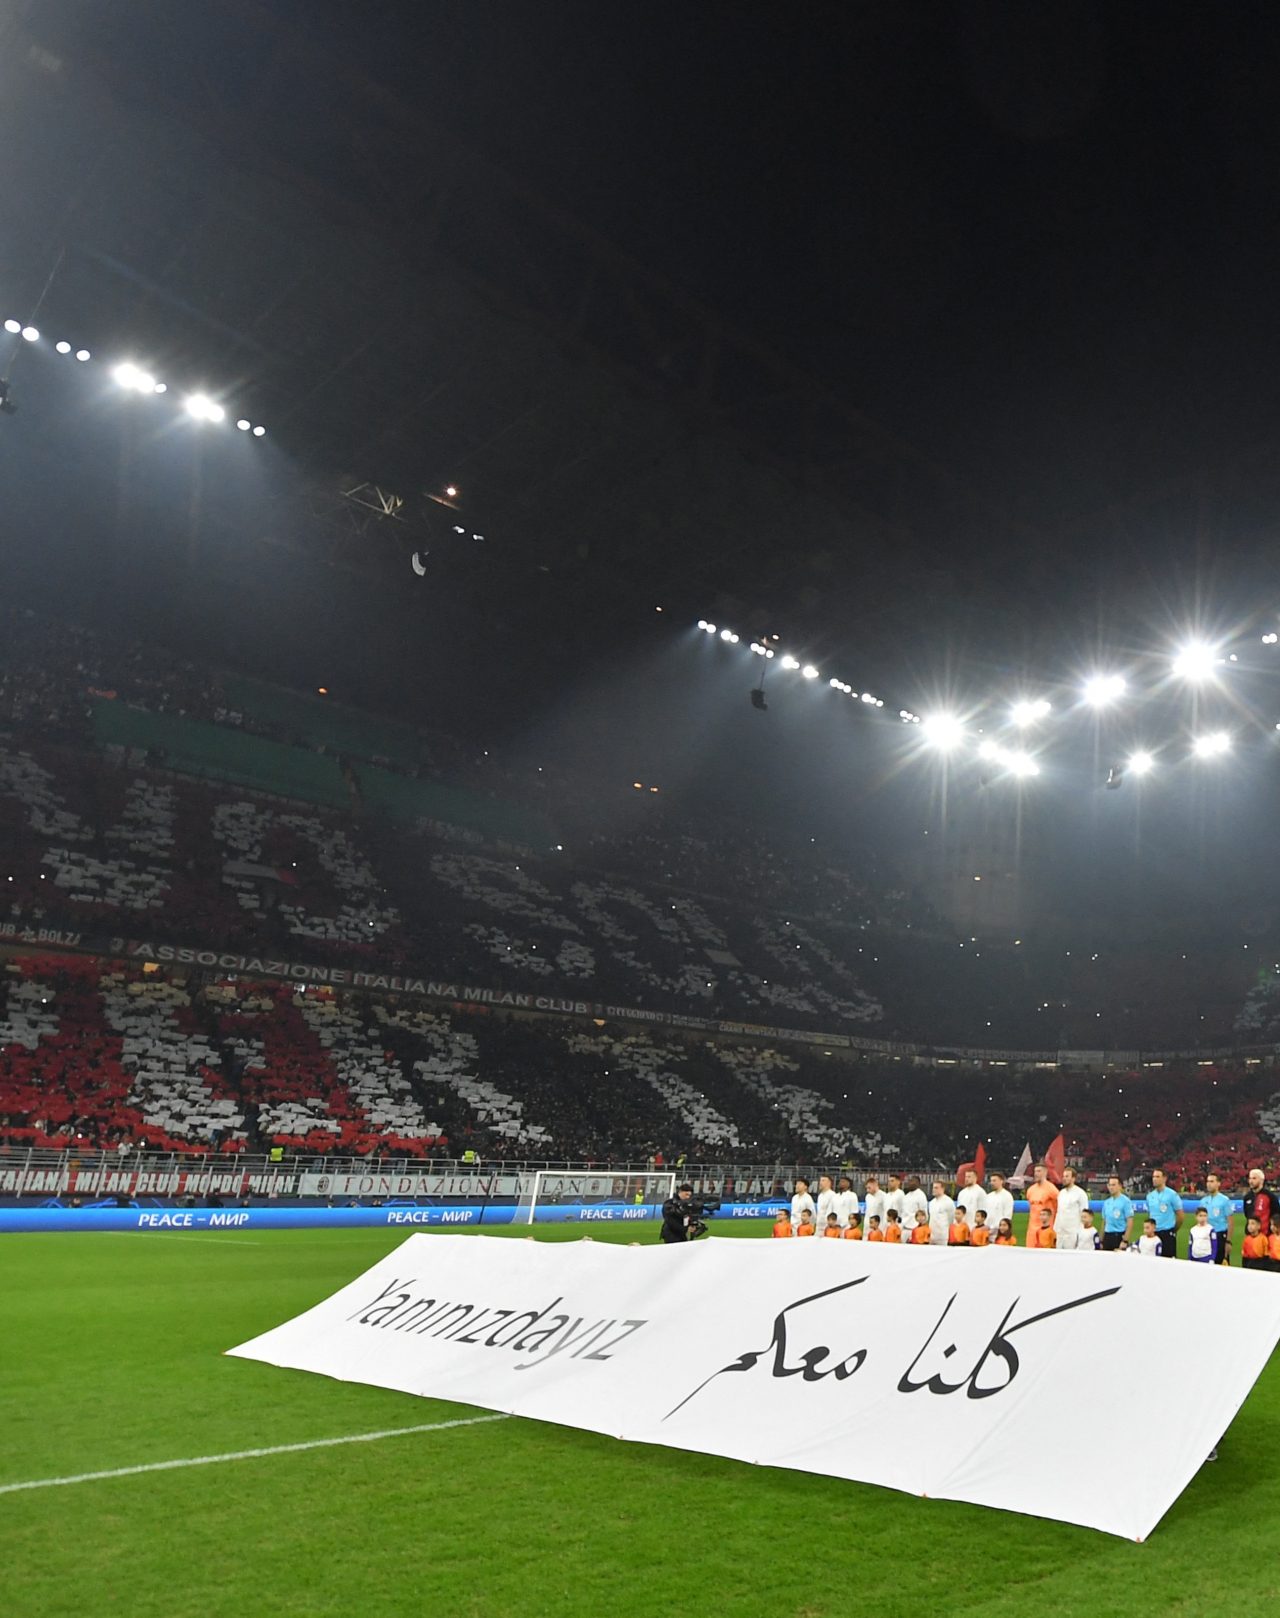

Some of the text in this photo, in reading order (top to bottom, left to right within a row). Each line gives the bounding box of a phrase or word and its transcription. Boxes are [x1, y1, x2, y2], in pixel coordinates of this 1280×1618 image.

[133, 942, 344, 984] ASSOCIAZIONE
[353, 973, 459, 998] ITALIANA
[463, 987, 529, 1007] MILAN
[535, 997, 588, 1014] CLUB
[75, 1171, 131, 1192] MILAN
[136, 1172, 180, 1193] CLUB
[184, 1174, 242, 1194] MONDO
[248, 1175, 296, 1194] MILAN
[343, 1176, 582, 1195] FONDAZIONE MLAN
[138, 1213, 193, 1227] PEACE
[387, 1211, 429, 1223] PEACE
[581, 1208, 613, 1219] PEACE
[733, 1207, 759, 1217] PEACE
[346, 1278, 649, 1370] Yanınızdayız
[660, 1275, 1122, 1422] كلنا معكم
